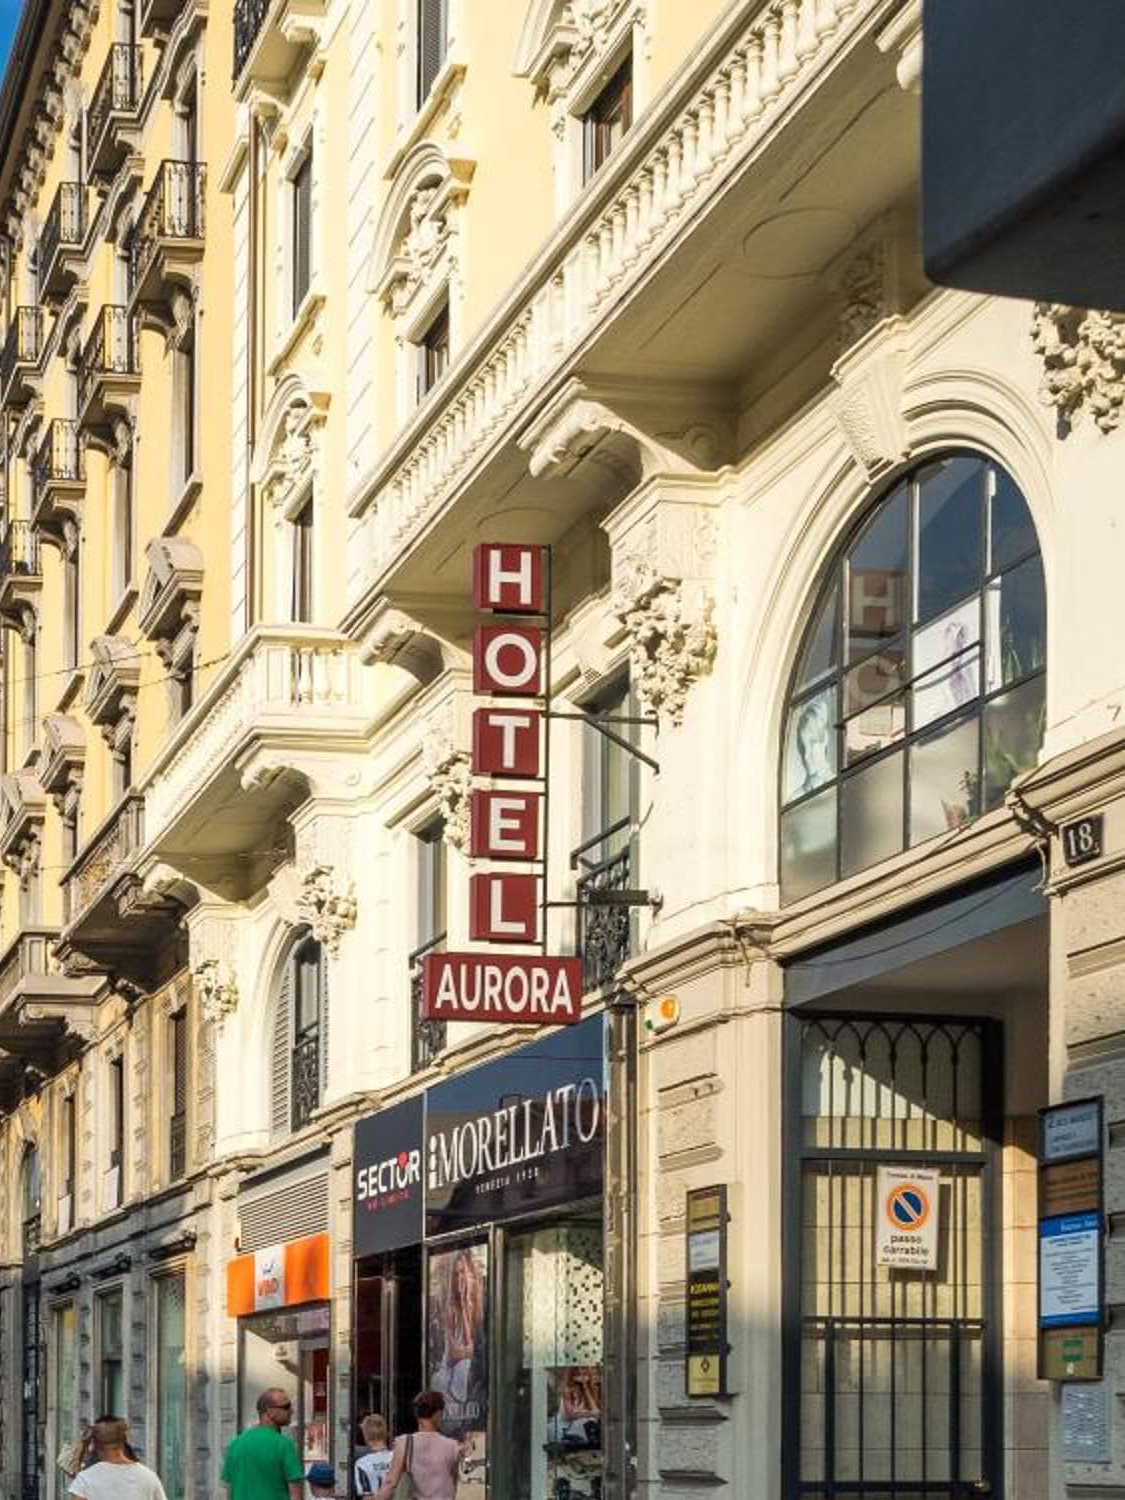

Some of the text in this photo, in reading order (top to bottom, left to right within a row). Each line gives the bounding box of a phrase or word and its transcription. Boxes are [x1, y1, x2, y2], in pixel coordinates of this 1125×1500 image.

[484, 549, 538, 934] HOTEL
[1067, 823, 1094, 857] 18
[434, 962, 574, 1015] AURORA
[438, 1078, 599, 1187] MORELLATO
[357, 1150, 421, 1200] SECTOR
[883, 1245, 929, 1256] carrabile
[890, 1234, 923, 1244] passo
